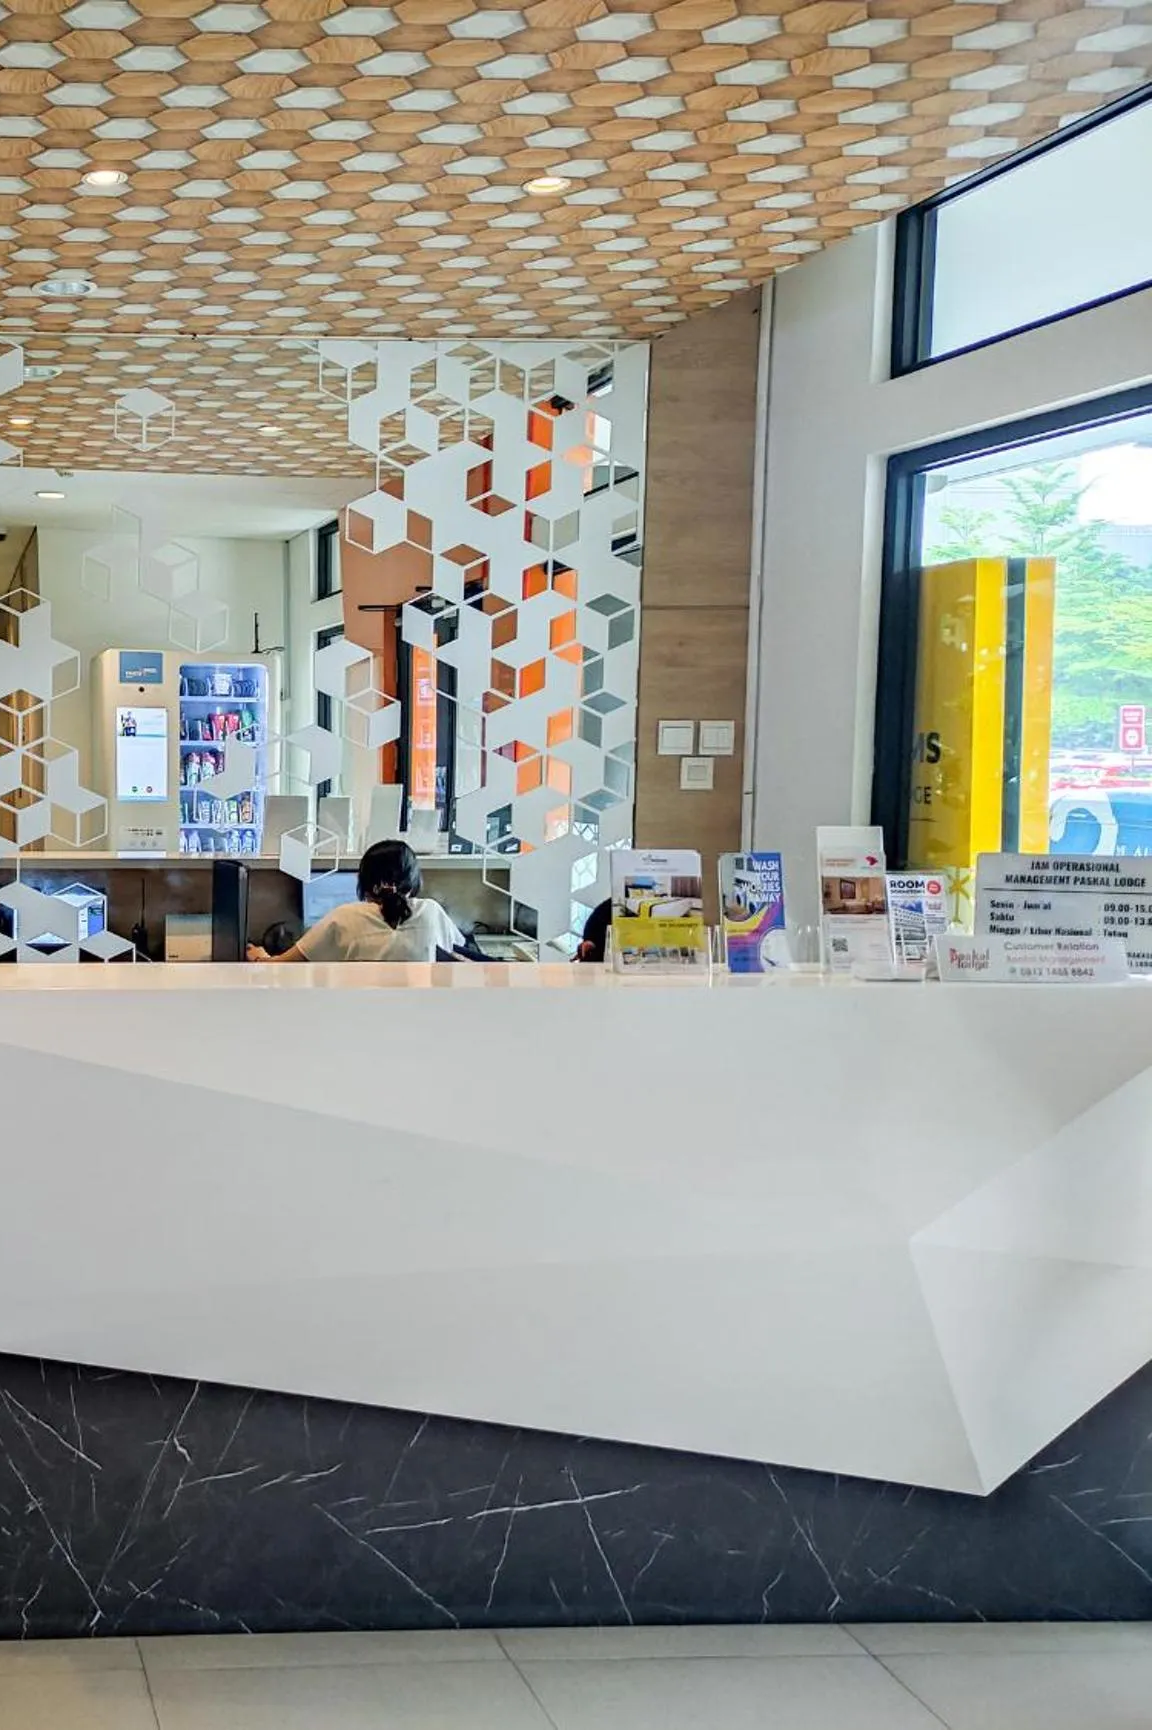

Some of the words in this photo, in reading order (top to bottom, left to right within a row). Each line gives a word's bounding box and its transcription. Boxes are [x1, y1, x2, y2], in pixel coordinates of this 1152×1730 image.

[752, 860, 779, 870] WASH
[1031, 860, 1050, 870] JAM
[1052, 861, 1121, 873] OPERASIONAL
[889, 879, 926, 889] ROOM
[1005, 874, 1070, 885] MANAGEMENT
[1073, 875, 1111, 887] PASKAL
[1114, 877, 1147, 888] LODGE
